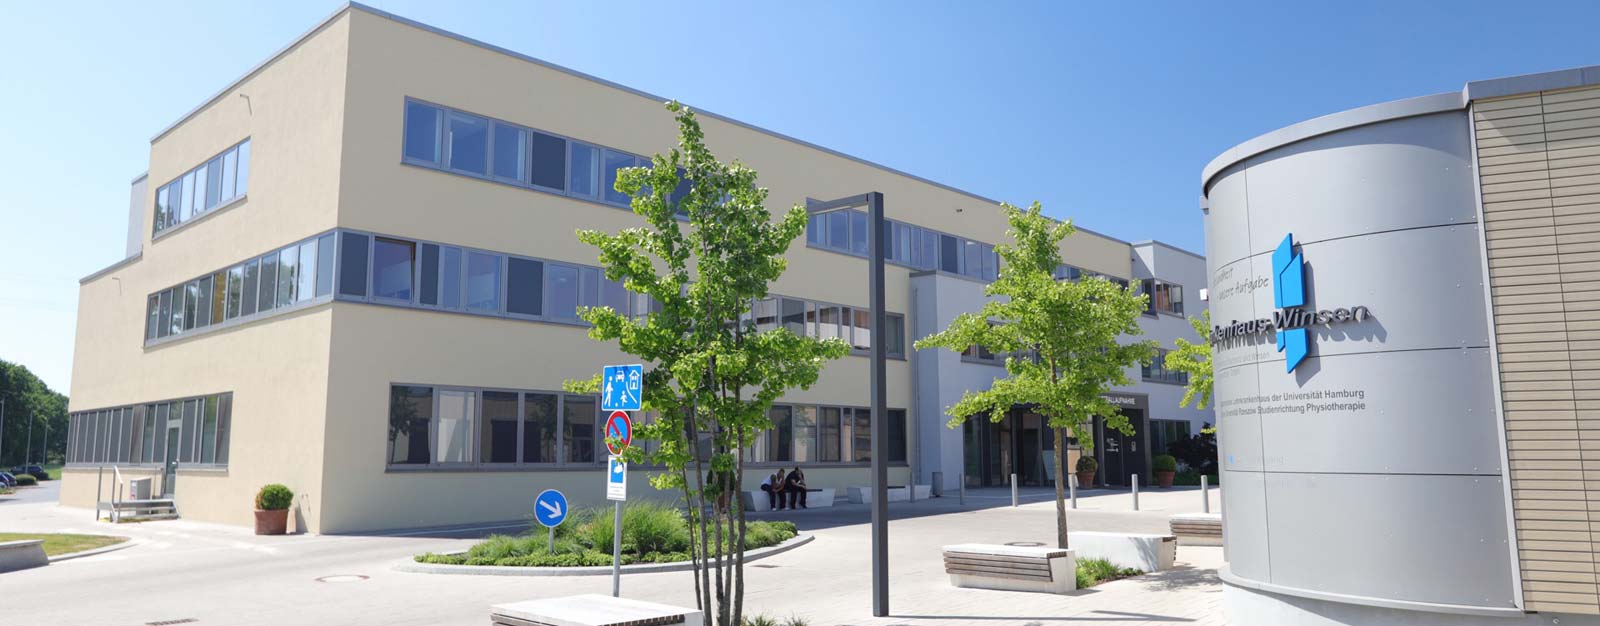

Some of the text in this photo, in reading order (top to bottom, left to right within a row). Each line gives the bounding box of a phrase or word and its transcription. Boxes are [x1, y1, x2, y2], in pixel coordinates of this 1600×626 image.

[1273, 305, 1369, 328] Winsen
[1271, 393, 1282, 402] der
[1283, 391, 1323, 401] Universität
[1325, 389, 1365, 399] Hamburg
[1257, 404, 1304, 414] Studienrichtung
[1306, 401, 1366, 412] Physiotherapie
